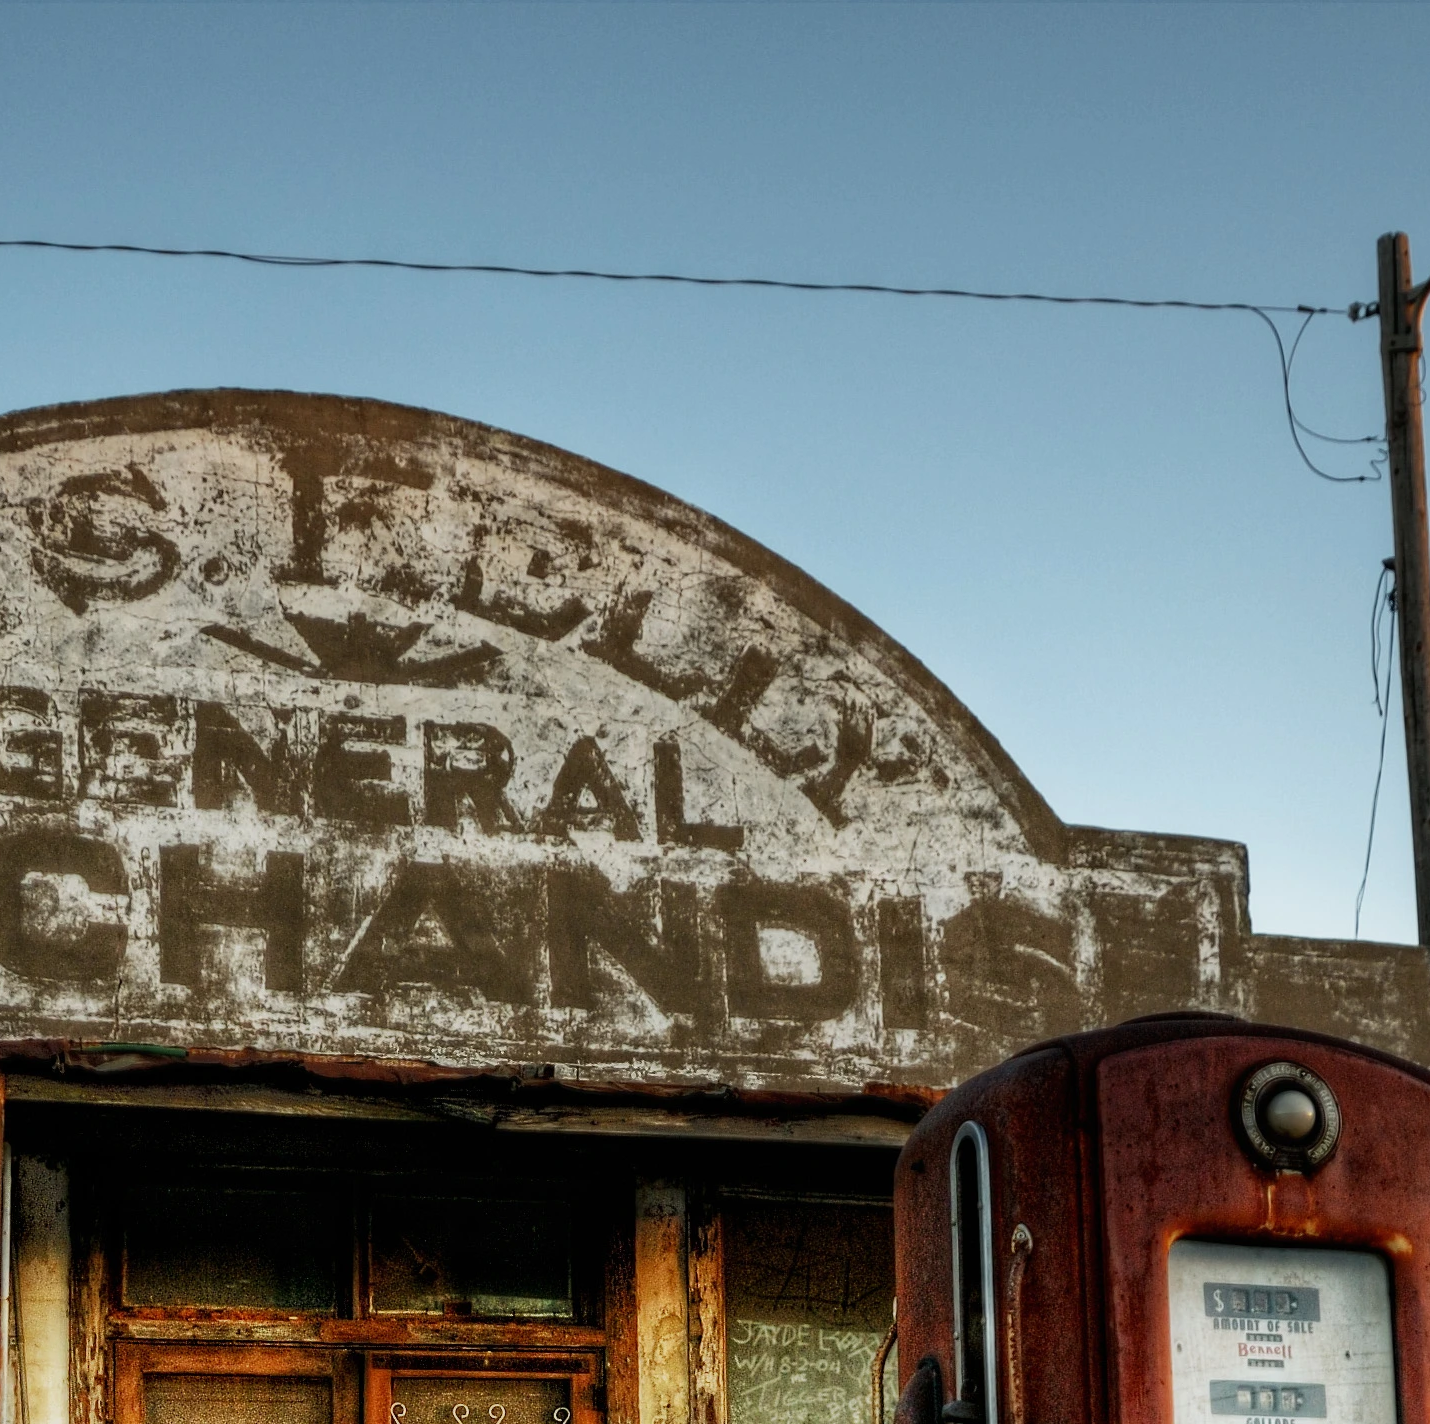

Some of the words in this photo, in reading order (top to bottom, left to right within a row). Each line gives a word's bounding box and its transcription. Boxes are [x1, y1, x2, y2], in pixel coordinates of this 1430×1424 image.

[1213, 1318, 1260, 1332] AMOUNT
[1267, 1320, 1281, 1333] OF
[1287, 1320, 1314, 1334] SALE
[1237, 1342, 1293, 1360] Bennett
